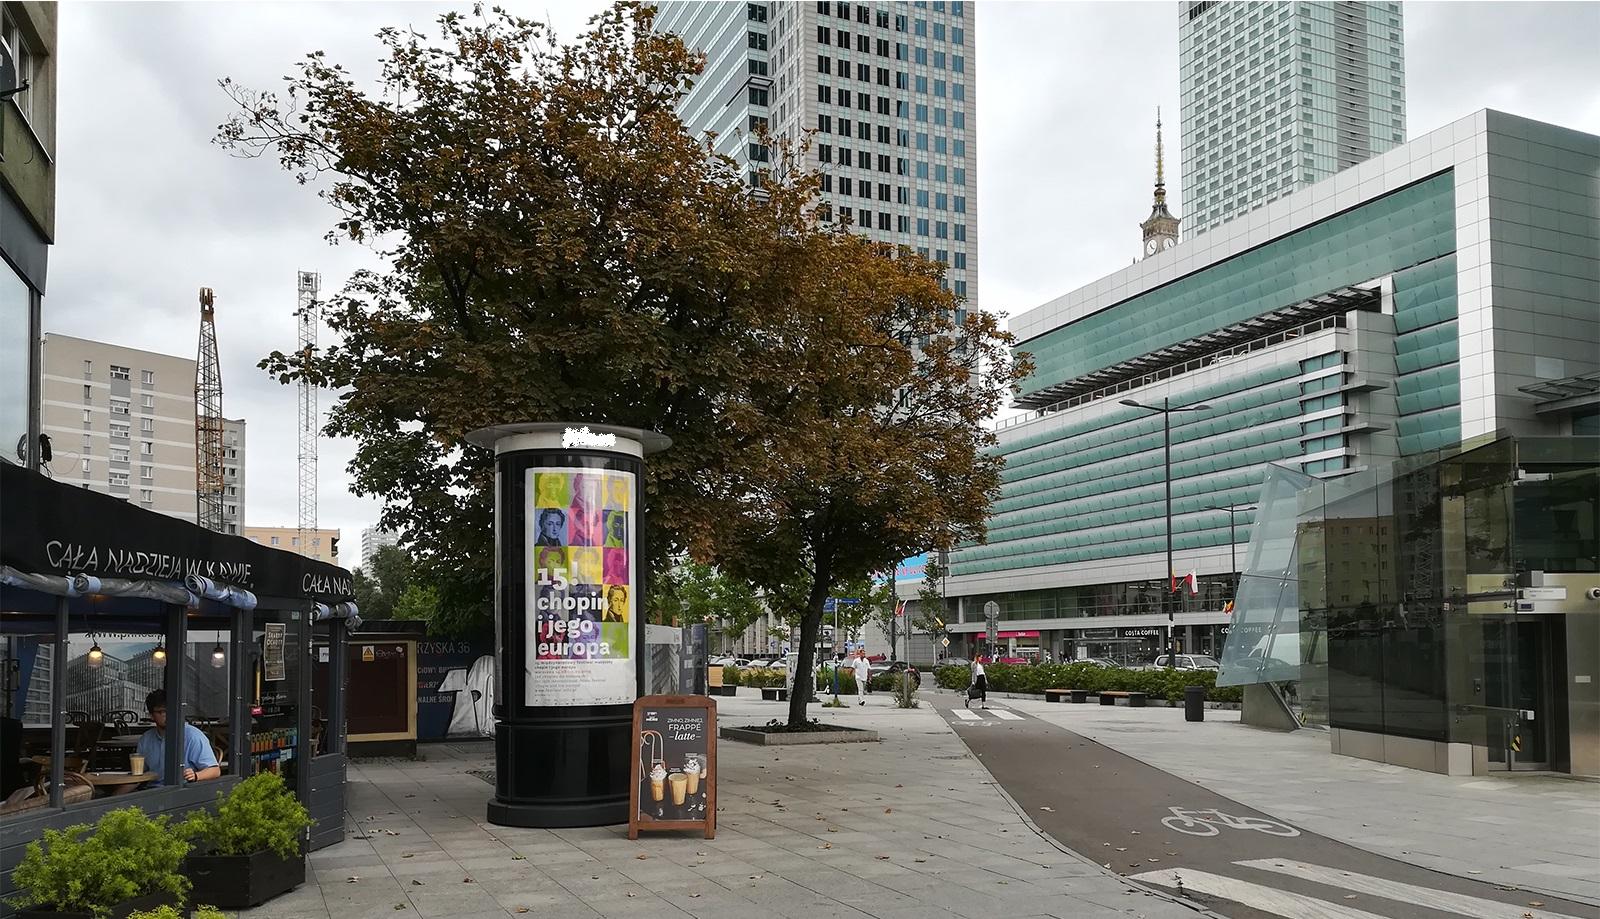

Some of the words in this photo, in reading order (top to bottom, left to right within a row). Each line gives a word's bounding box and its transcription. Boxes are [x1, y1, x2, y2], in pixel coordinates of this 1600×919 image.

[46, 540, 99, 571] CAŁA
[103, 547, 181, 579] NADZIEJA
[185, 557, 203, 577] W
[302, 572, 332, 594] CAŁA
[537, 561, 578, 590] 15!
[537, 592, 609, 614] chopin
[537, 615, 544, 633] i
[545, 615, 593, 639] jego
[537, 641, 610, 659] europa
[674, 731, 697, 741] latte
